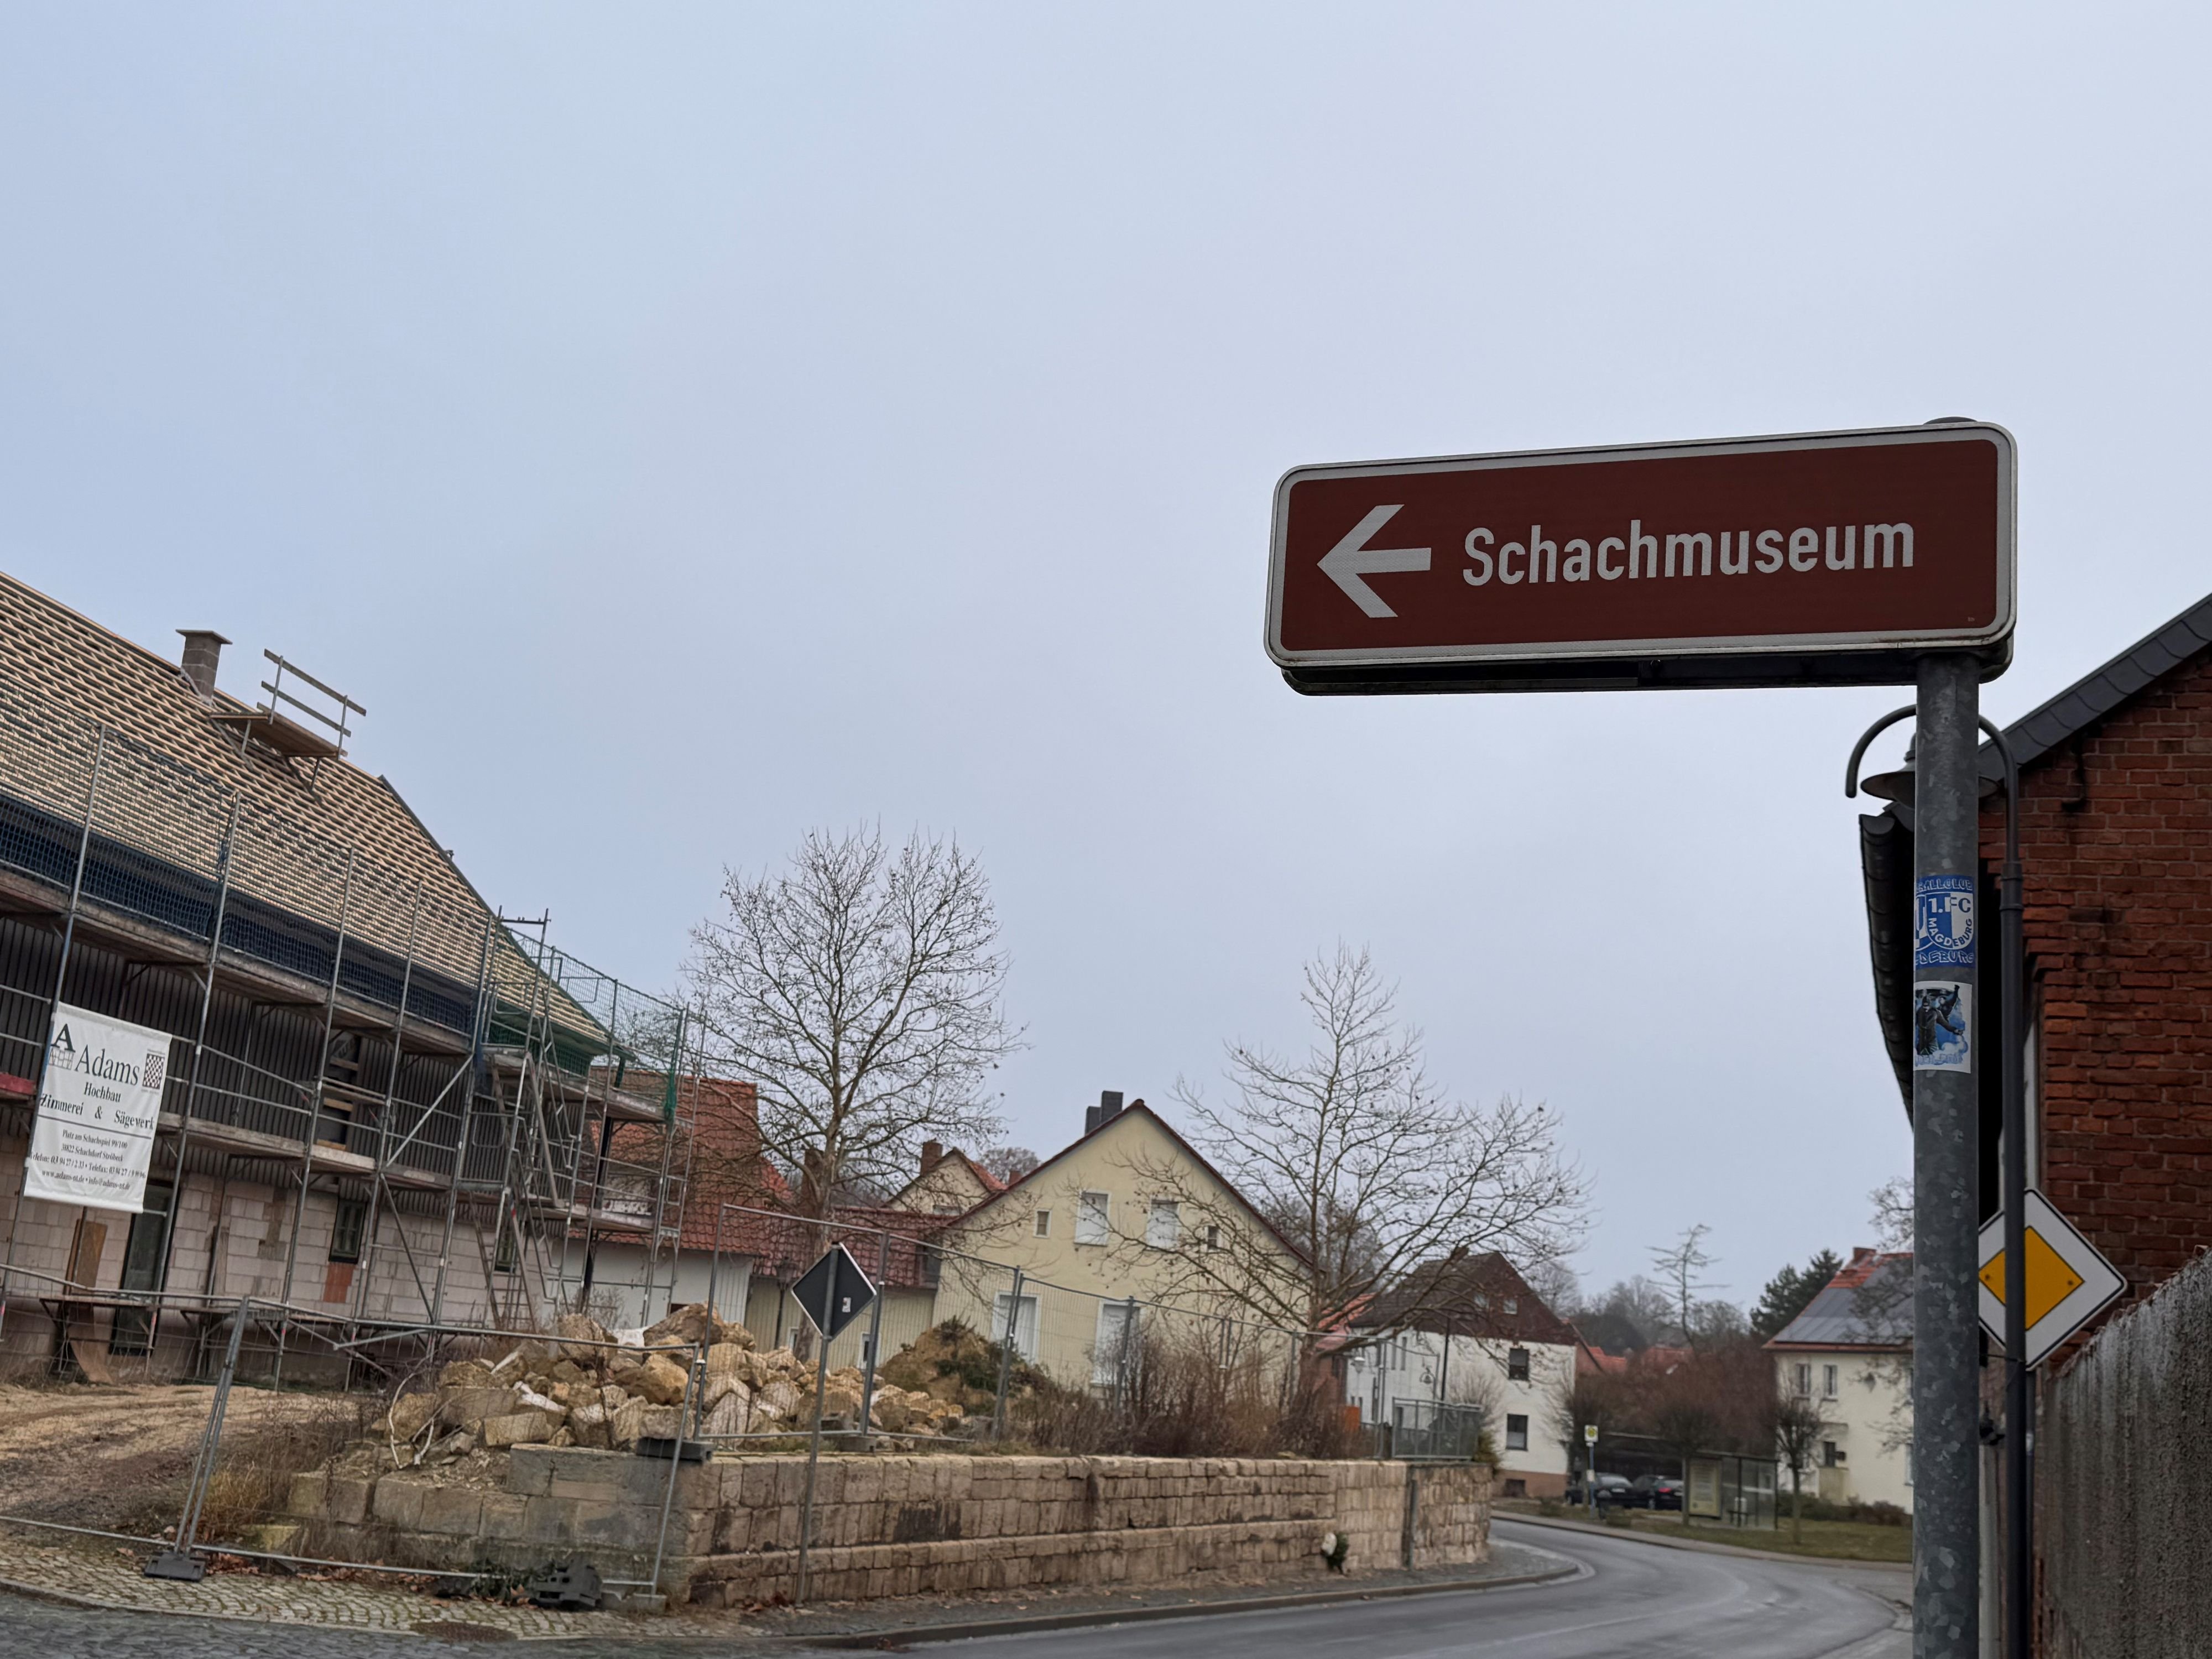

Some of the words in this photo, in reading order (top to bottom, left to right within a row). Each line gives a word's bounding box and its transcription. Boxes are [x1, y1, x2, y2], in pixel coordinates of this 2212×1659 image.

[1463, 519, 1914, 586] Schachmuseum
[1928, 917, 1973, 947] MAGDEBURG
[74, 1044, 140, 1086] Adams
[84, 1082, 122, 1103] Hochbau
[40, 1093, 84, 1115] Zimmerei
[95, 1106, 102, 1120] &
[114, 1109, 154, 1130] Sägewerk
[62, 1129, 74, 1139] Platz
[82, 1134, 111, 1147] Schachspiel
[75, 1146, 102, 1159] Schachdorf
[102, 1151, 123, 1162] Ströbeck
[89, 1162, 108, 1173] Telefax:
